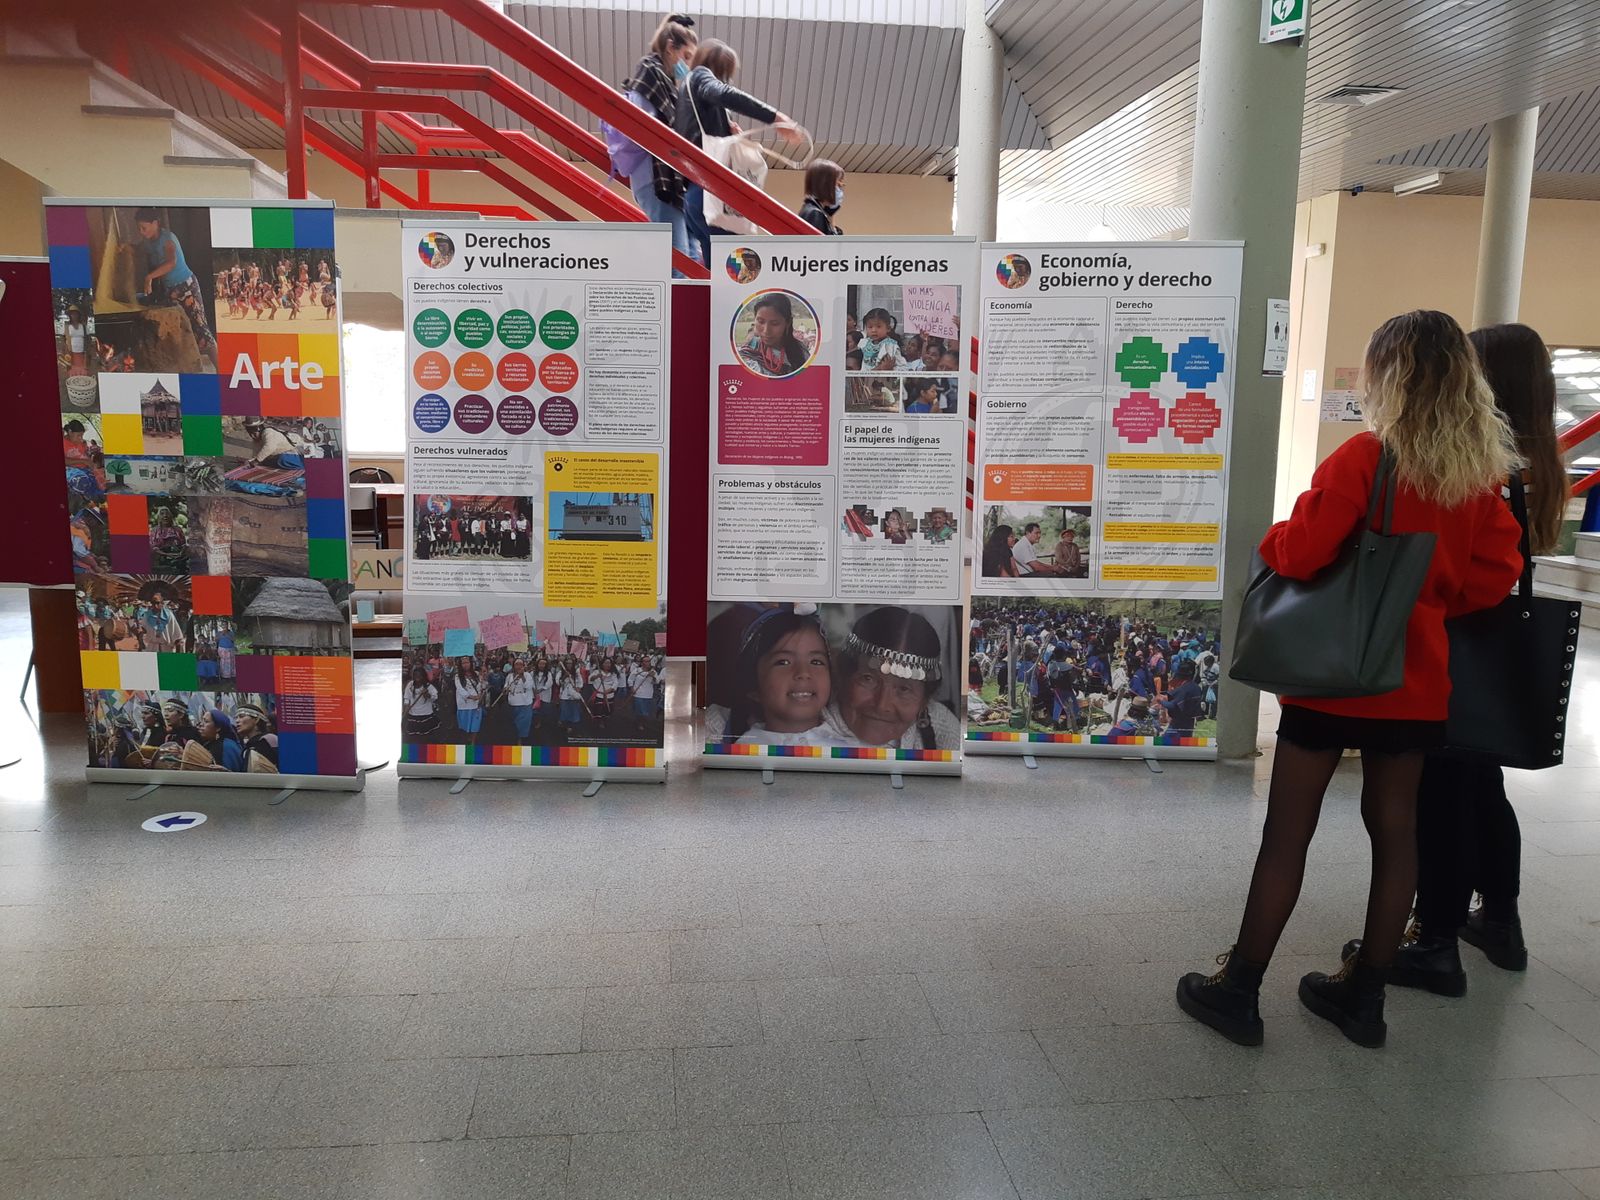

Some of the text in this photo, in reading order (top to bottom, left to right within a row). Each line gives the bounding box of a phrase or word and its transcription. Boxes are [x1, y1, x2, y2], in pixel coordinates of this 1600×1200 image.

[464, 232, 551, 249] Derechos
[464, 252, 609, 272] y vulneraciones
[771, 255, 948, 276] Mujeres indígenas
[1041, 253, 1132, 270] Economía,
[1038, 272, 1212, 291] gobierno y derecho
[413, 282, 503, 292] Derechos colectivos
[908, 288, 934, 296] NO MAS
[909, 299, 951, 313] VIOLENCIA
[990, 301, 1033, 310] Economía
[1116, 301, 1153, 309] Derecho
[909, 314, 943, 324] CONTRA LAS
[914, 323, 953, 336] MUJERES
[229, 352, 323, 390] Arte
[987, 400, 1027, 408] Gobierno
[844, 425, 893, 435] El papel de
[844, 435, 941, 445] las mujeres indígenas
[413, 446, 508, 456] Derechos vulnerados
[718, 479, 765, 488] Problemas
[774, 480, 822, 489] obstáculos
[608, 515, 627, 526] 310
